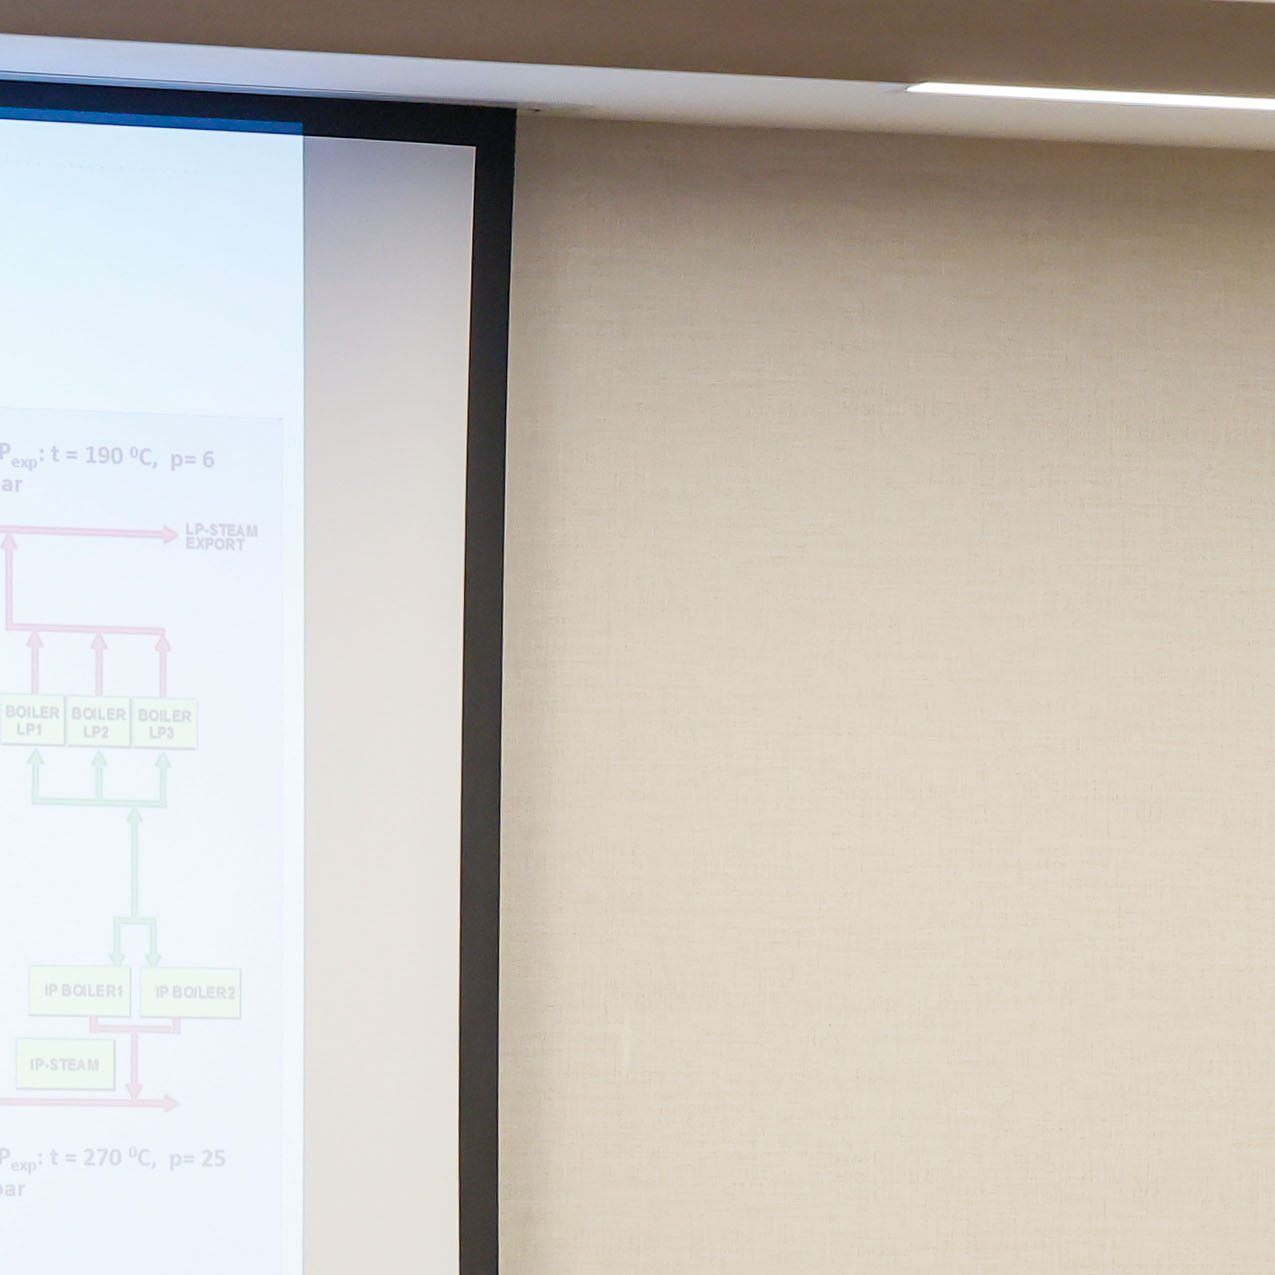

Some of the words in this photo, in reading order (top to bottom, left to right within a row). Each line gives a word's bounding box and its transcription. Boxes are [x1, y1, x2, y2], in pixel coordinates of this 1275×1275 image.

[51, 445, 60, 462] t
[85, 445, 124, 464] 190
[202, 451, 215, 468] 6
[185, 523, 258, 537] LP-STEAM
[185, 537, 244, 551] EXPORT
[5, 705, 59, 719] BOILER
[72, 707, 126, 721] BOILER
[138, 709, 191, 722] BOILER
[17, 723, 42, 736] LP1
[84, 725, 109, 738] LP2
[149, 726, 174, 739] LP3
[44, 984, 58, 997] IP
[61, 984, 123, 998] BOILER1
[156, 985, 169, 998] IP
[172, 985, 235, 999] BOILER2
[30, 1058, 99, 1072] IP-STEAM
[50, 1151, 59, 1166] t
[84, 1150, 122, 1167] 270
[202, 1151, 225, 1167] 25
